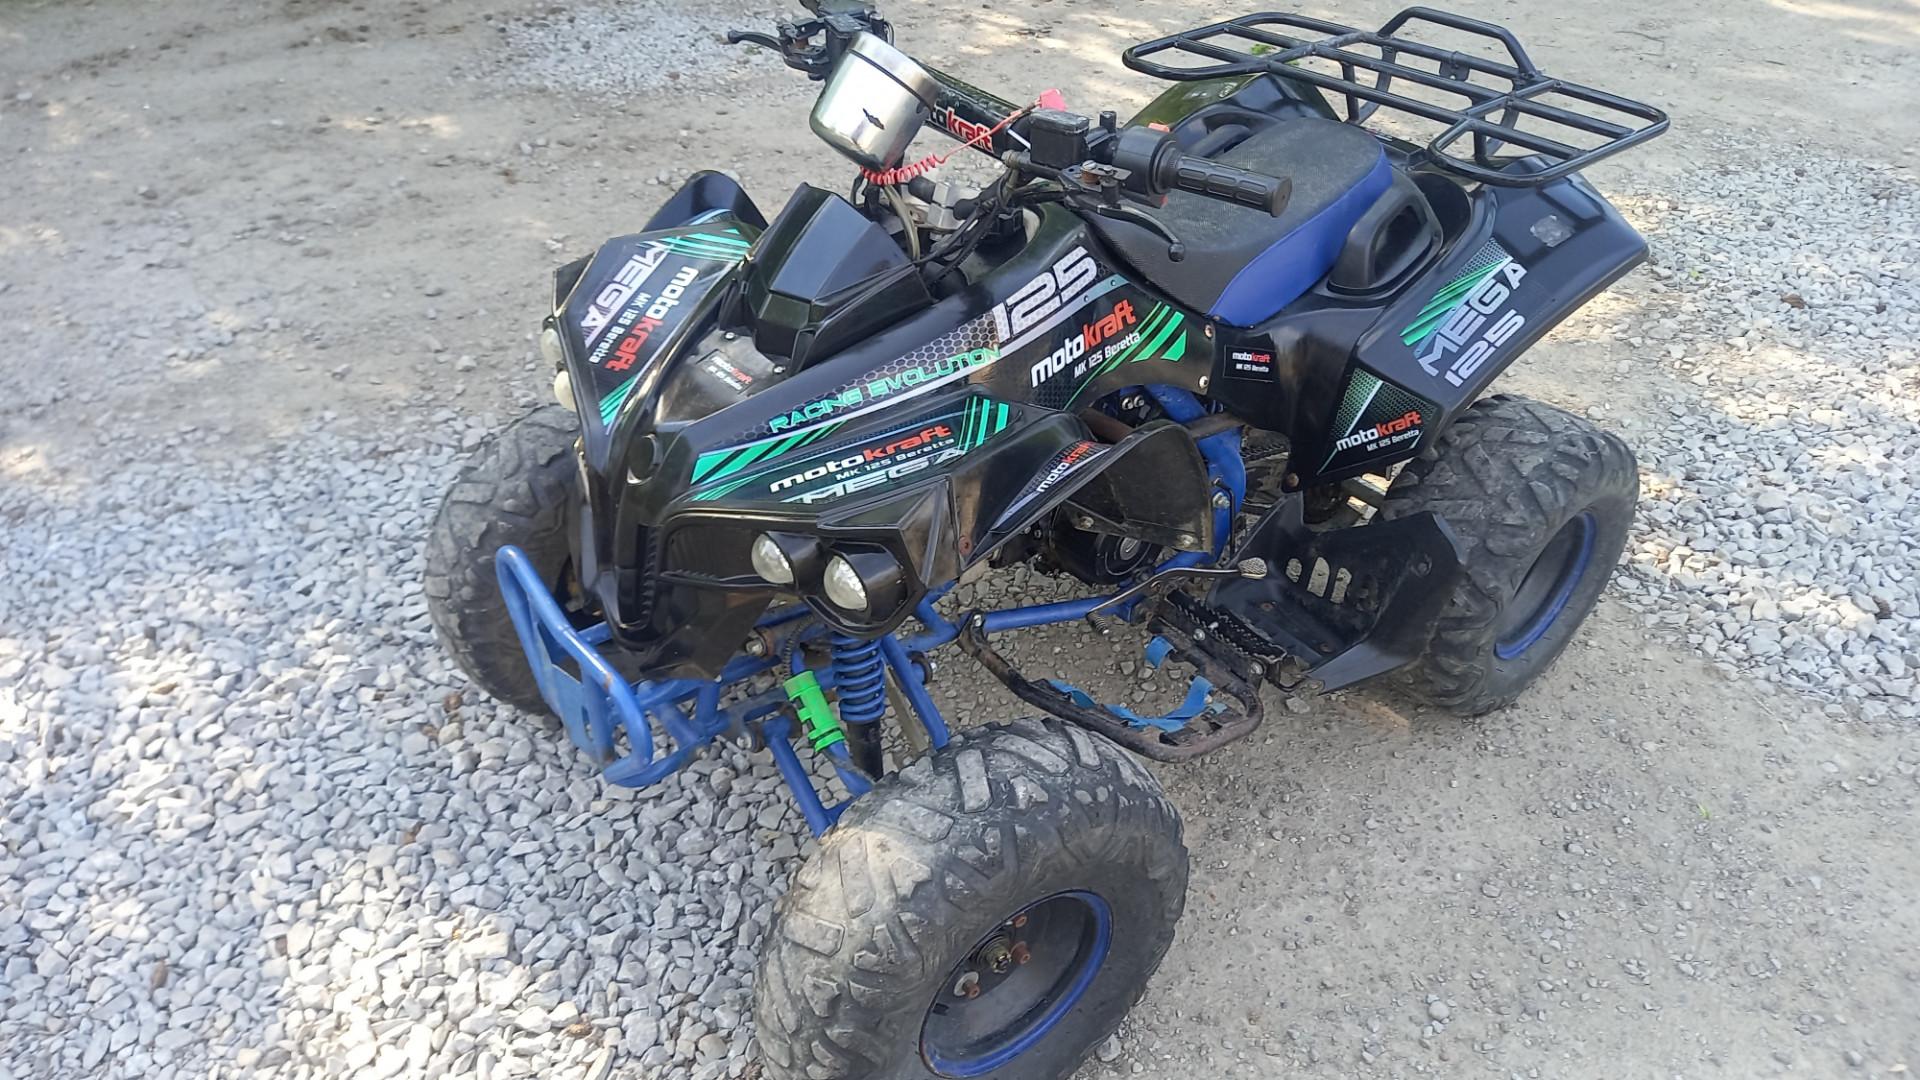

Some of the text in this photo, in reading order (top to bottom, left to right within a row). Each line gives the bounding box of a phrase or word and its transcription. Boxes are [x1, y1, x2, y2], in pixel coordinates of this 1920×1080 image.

[581, 240, 671, 349] MEGA
[589, 292, 652, 364] MK 125 Beretta
[605, 266, 699, 371] motokraft
[992, 246, 1098, 344] 125
[1418, 262, 1527, 376] MEGA
[1030, 299, 1137, 388] motokraft
[1088, 350, 1103, 368] 125
[1104, 332, 1140, 358] Beretta
[1232, 351, 1271, 363] motokraft
[1444, 309, 1526, 388] 125
[769, 344, 1002, 434] RACING EVOLUTION
[770, 425, 952, 493] motokraft
[836, 438, 955, 481] MK 125 Beretta
[1336, 411, 1422, 451] motokraft
[1366, 429, 1419, 452] MK 125 Beretta
[780, 447, 965, 504] MEGA
